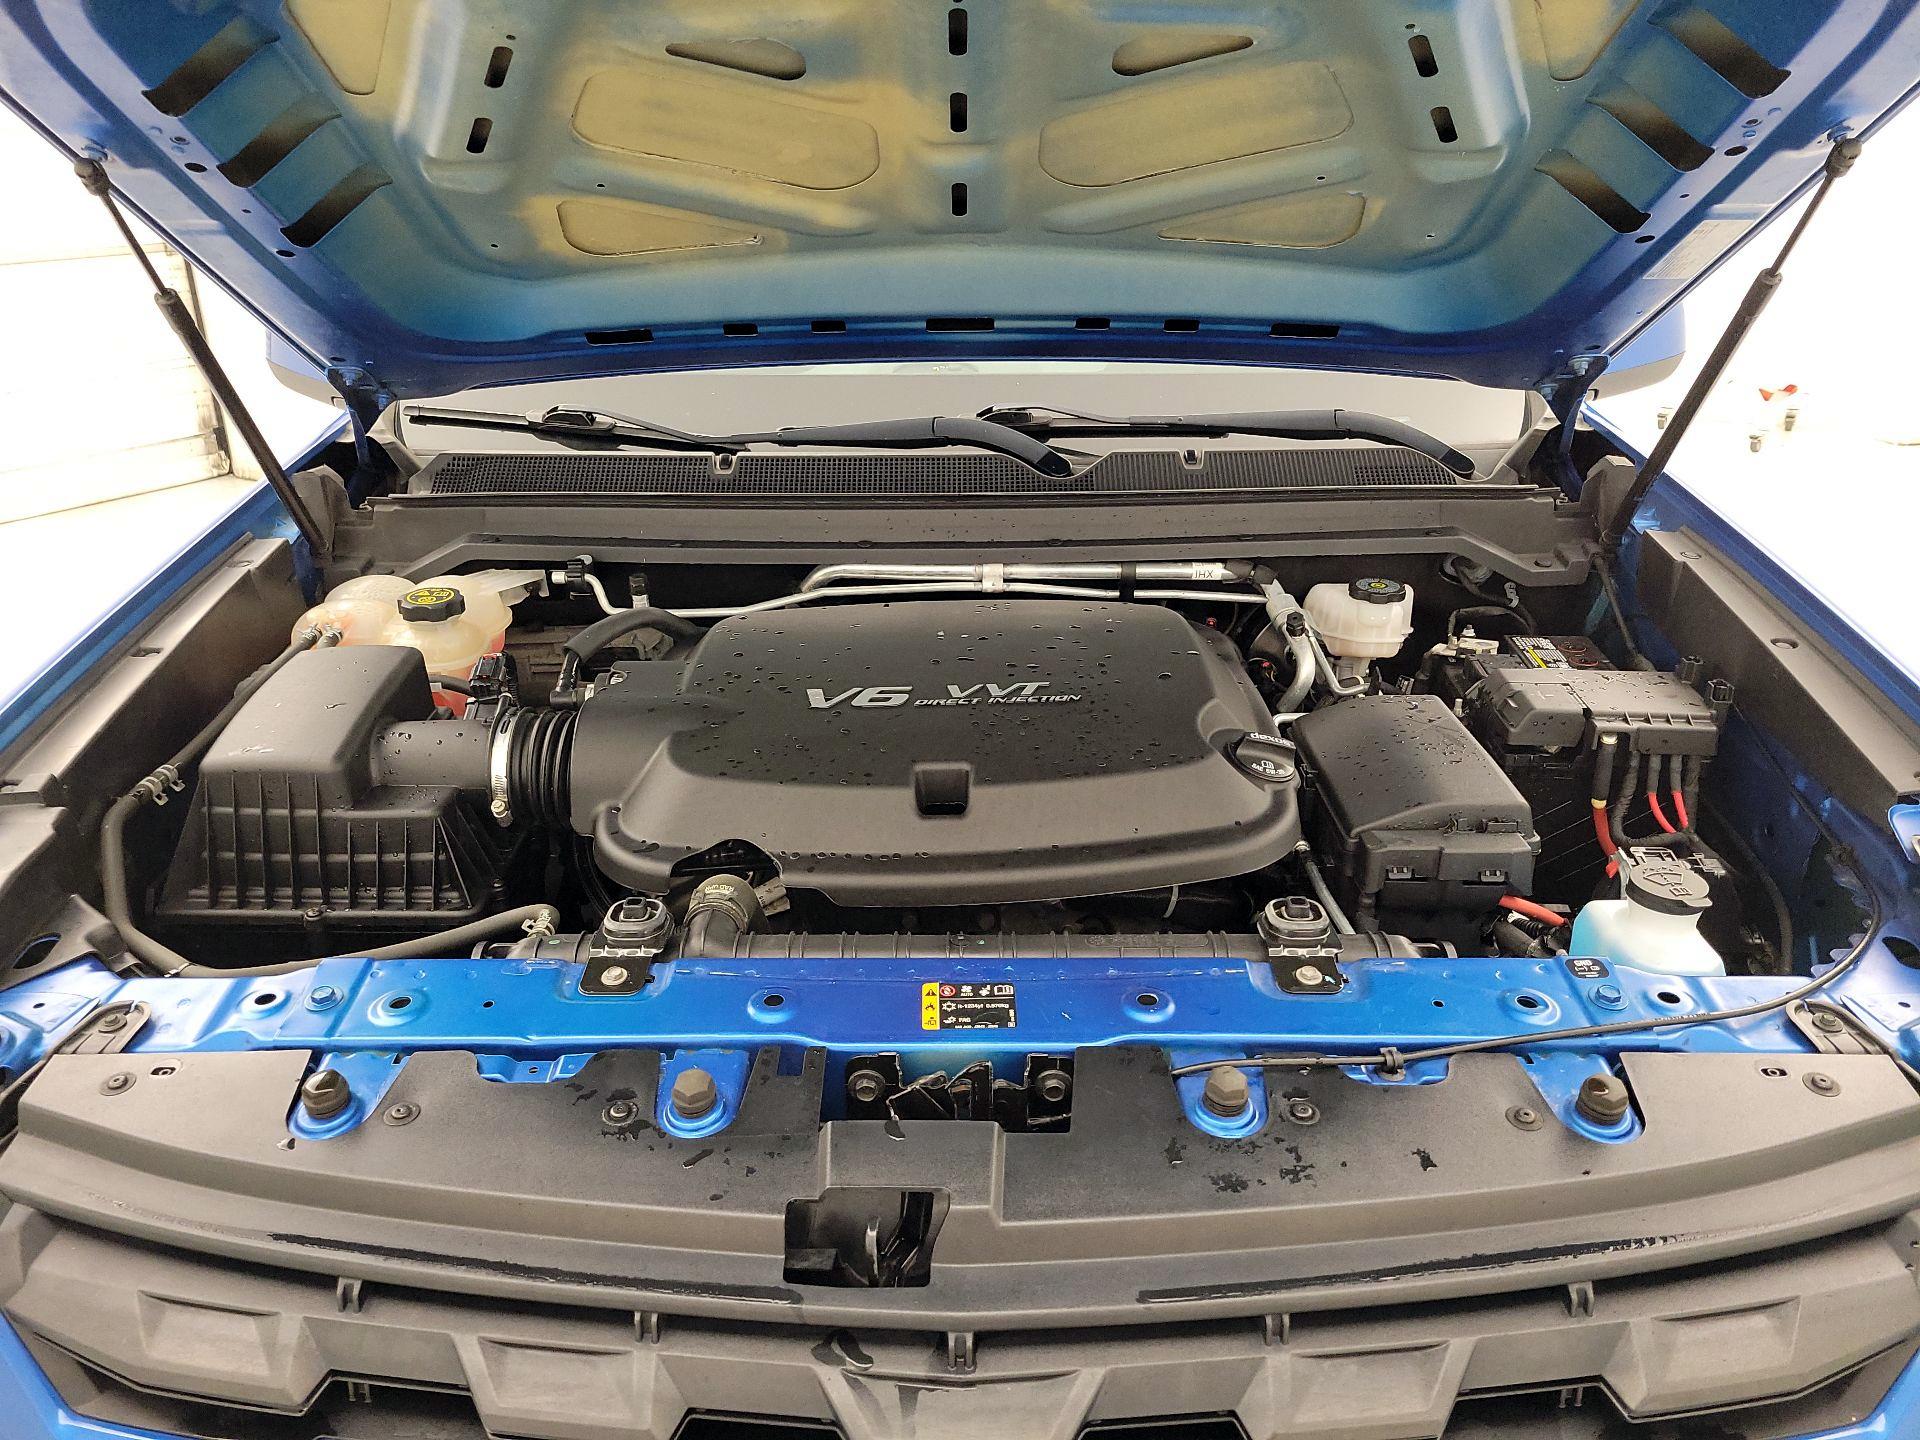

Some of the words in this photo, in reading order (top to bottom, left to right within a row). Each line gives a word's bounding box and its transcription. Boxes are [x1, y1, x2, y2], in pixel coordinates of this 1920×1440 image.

[1194, 570, 1214, 579] JHX
[806, 685, 913, 709] V6
[946, 681, 1050, 698] VVT
[913, 697, 981, 707] DIRECT
[987, 694, 1082, 705] INJECTION
